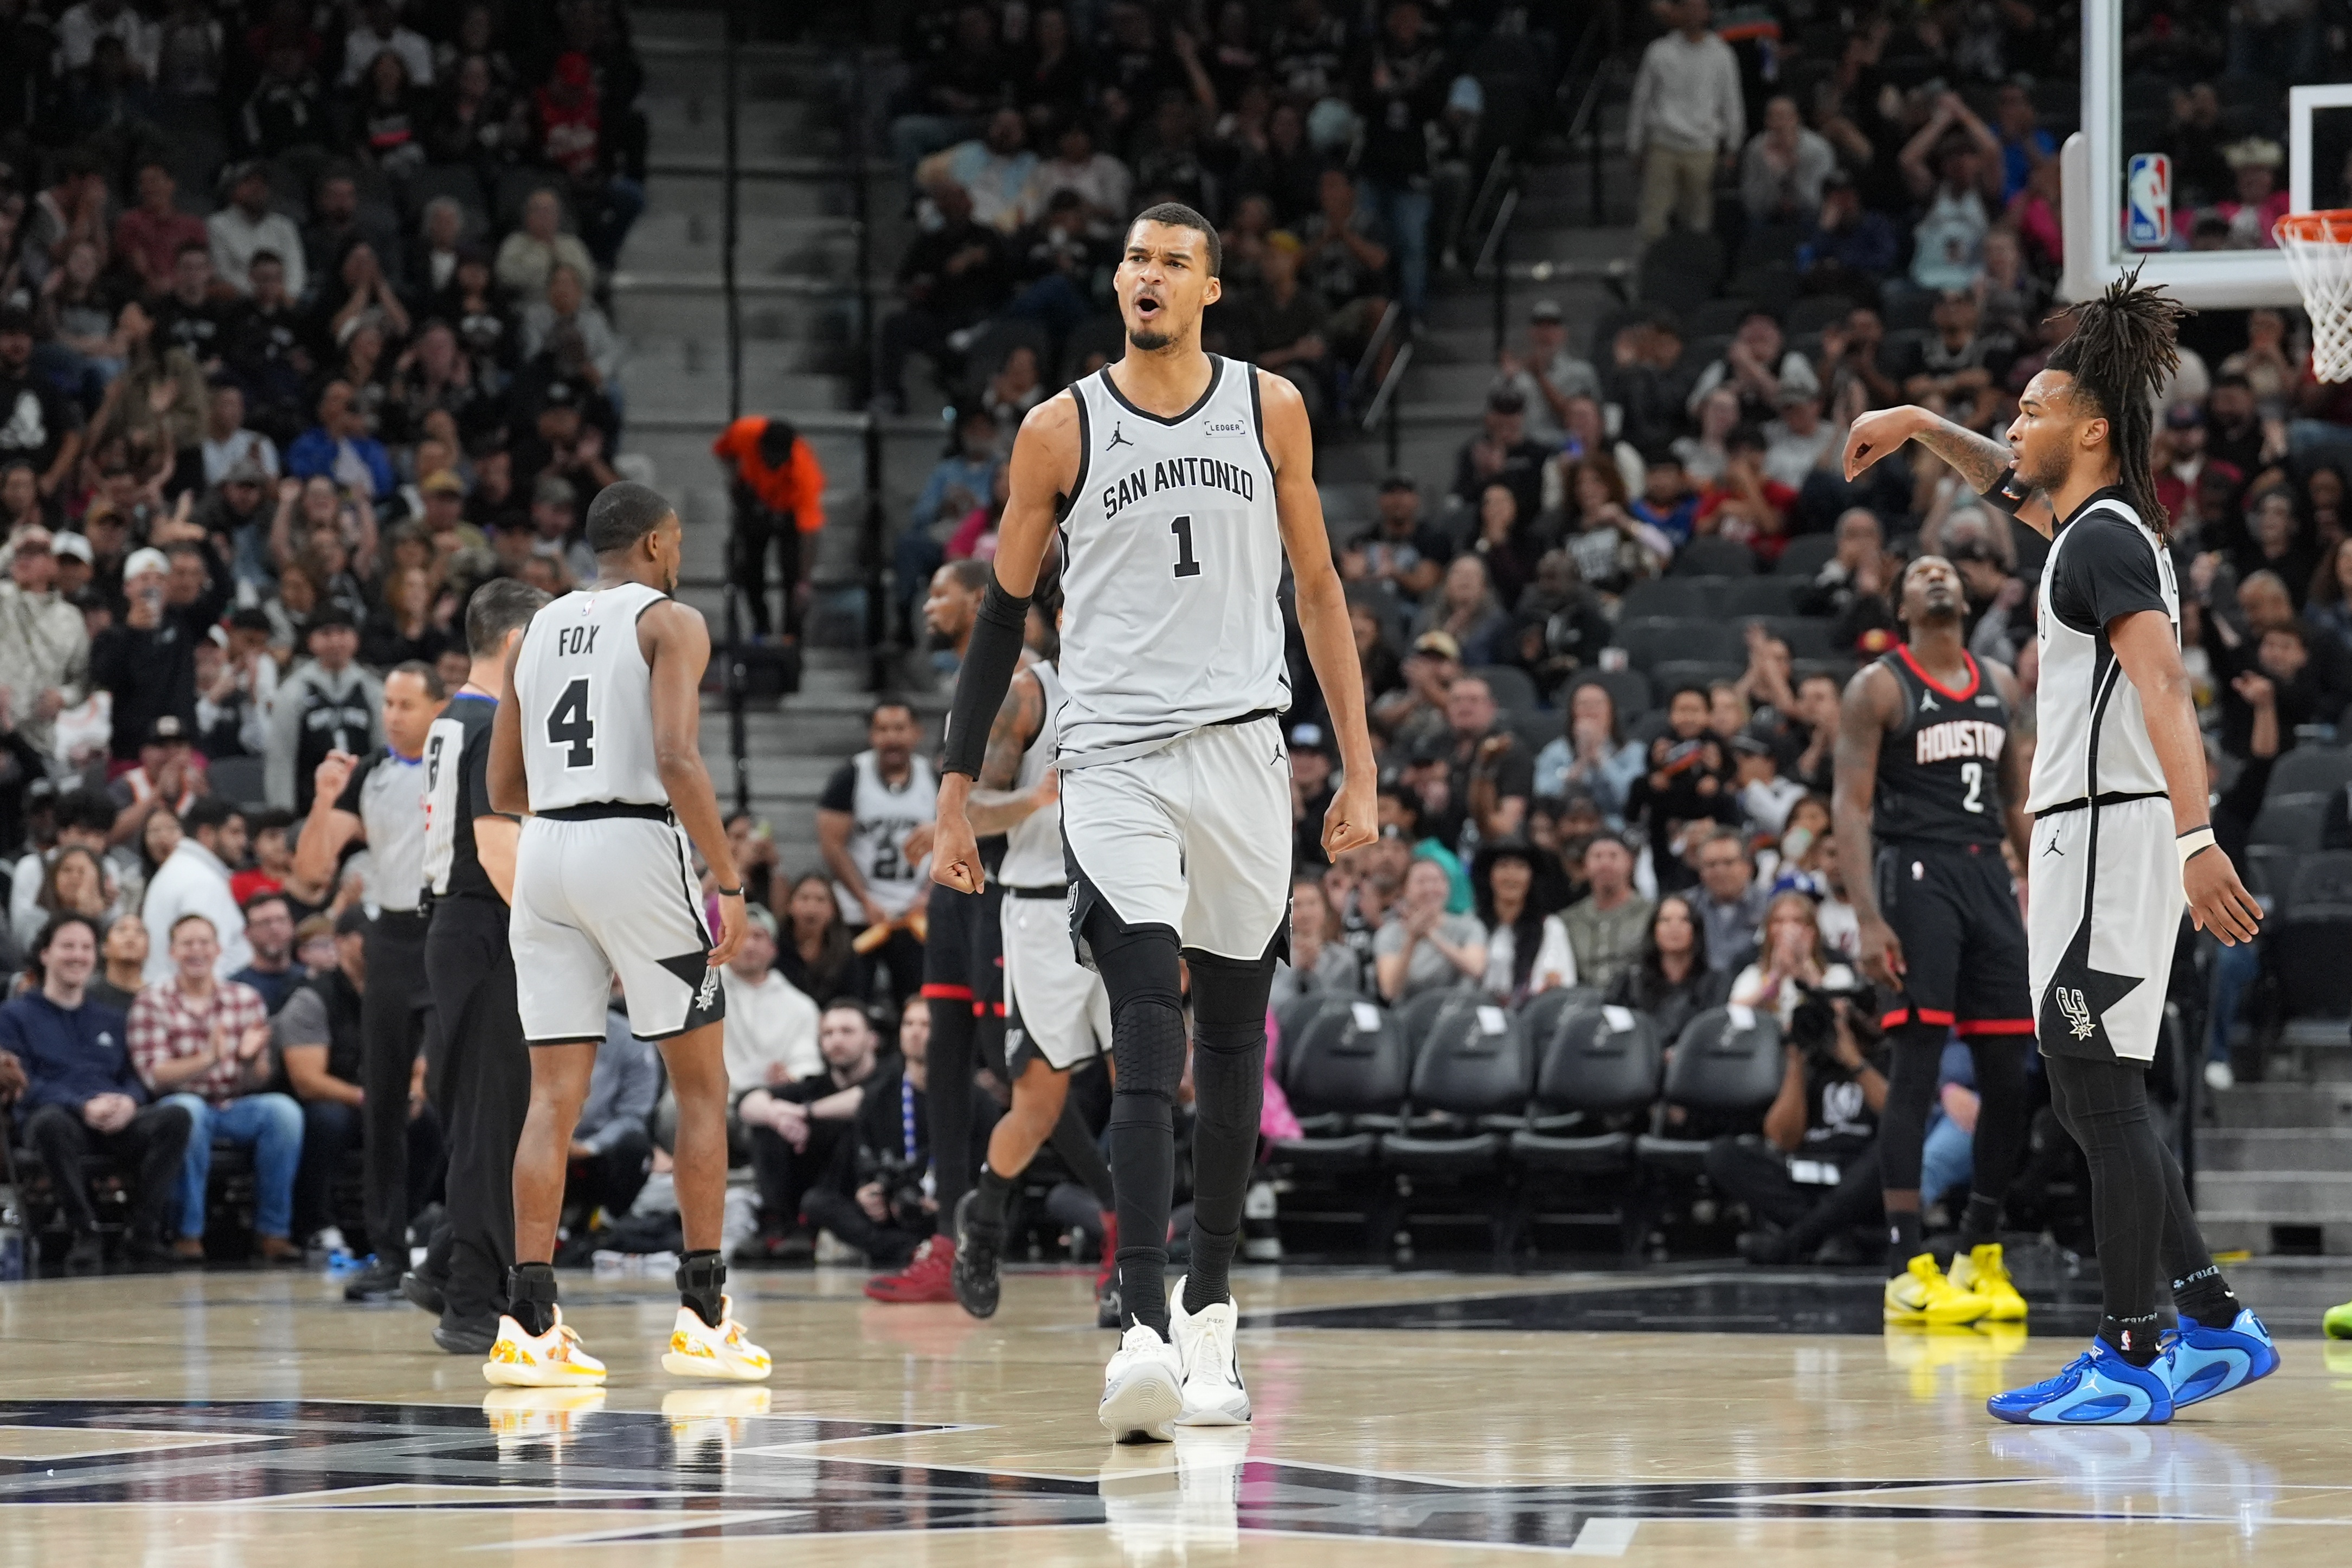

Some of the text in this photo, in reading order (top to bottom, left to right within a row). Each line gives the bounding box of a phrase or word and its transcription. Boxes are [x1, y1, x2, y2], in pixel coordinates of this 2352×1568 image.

[1103, 457, 1254, 521] SAN ANTONIO
[1170, 515, 1202, 579] 1
[558, 625, 600, 657] FOX
[546, 677, 595, 769] 4
[1961, 762, 1984, 813] 2
